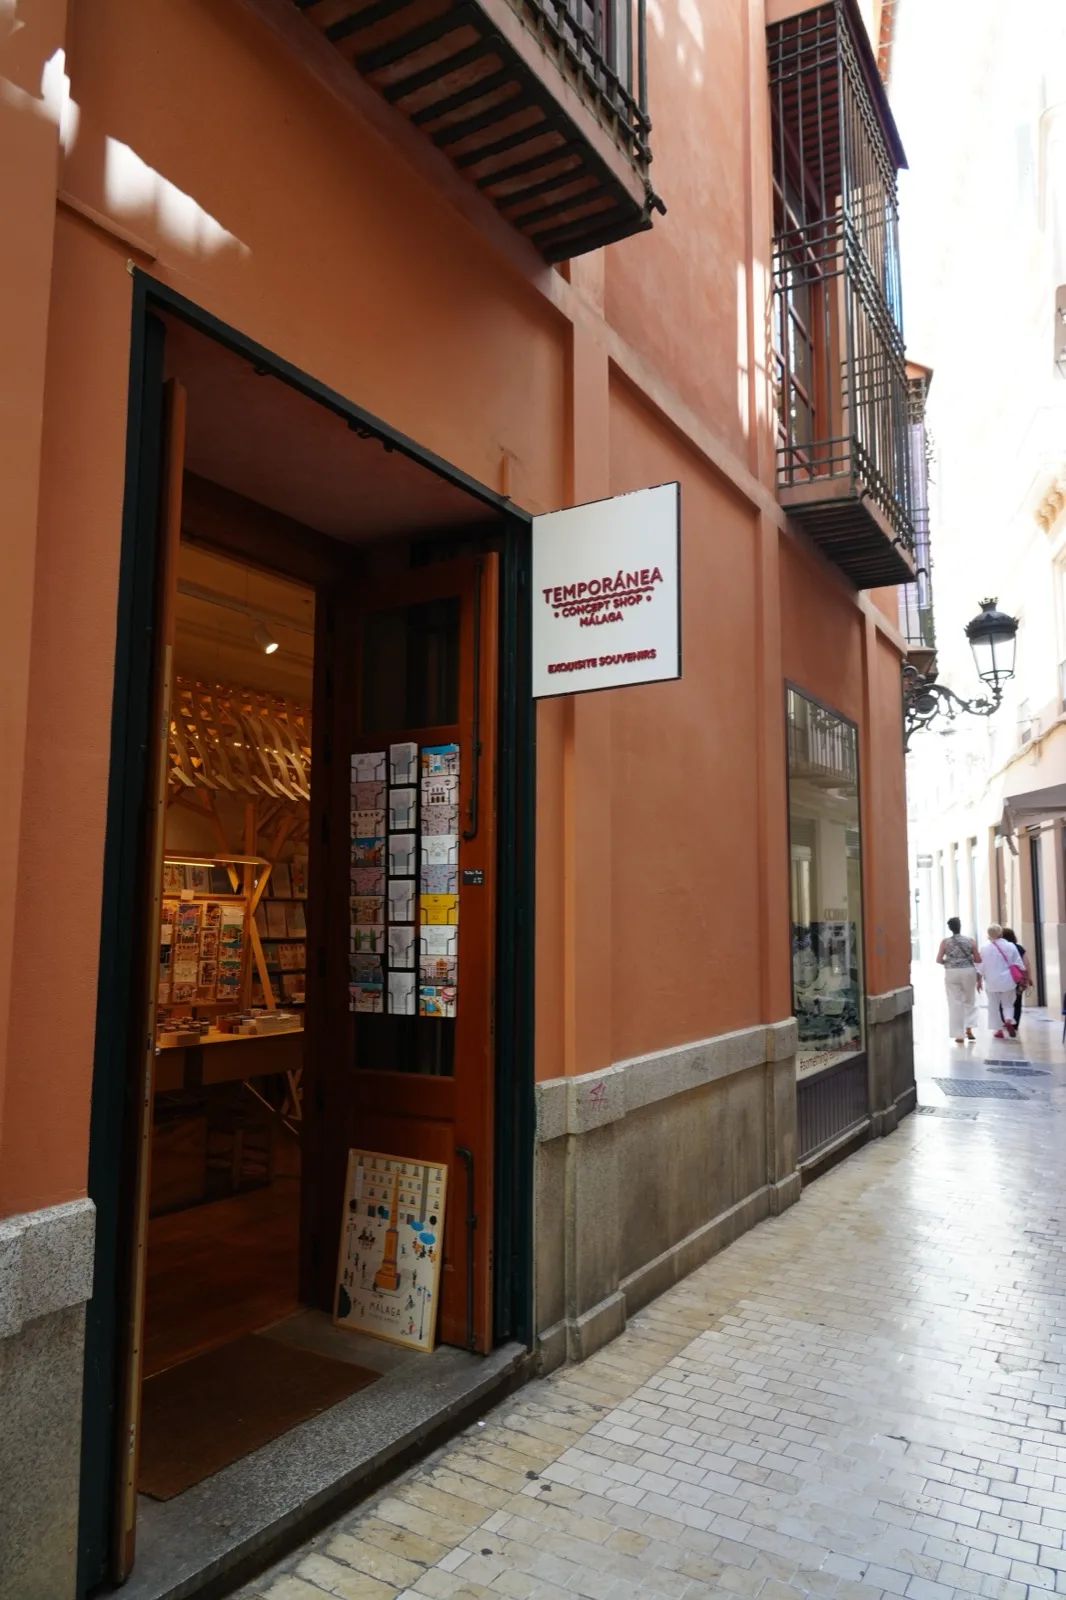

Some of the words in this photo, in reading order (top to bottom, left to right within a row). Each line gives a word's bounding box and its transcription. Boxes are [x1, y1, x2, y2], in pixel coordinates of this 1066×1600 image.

[543, 567, 663, 604] TEMPORÁNEA
[562, 600, 610, 617] CONCEPT
[613, 595, 643, 609] SHOP
[580, 611, 624, 627] MÁLAGA
[548, 658, 597, 673] EXQUISITE
[599, 649, 657, 666] SOUVENIRS
